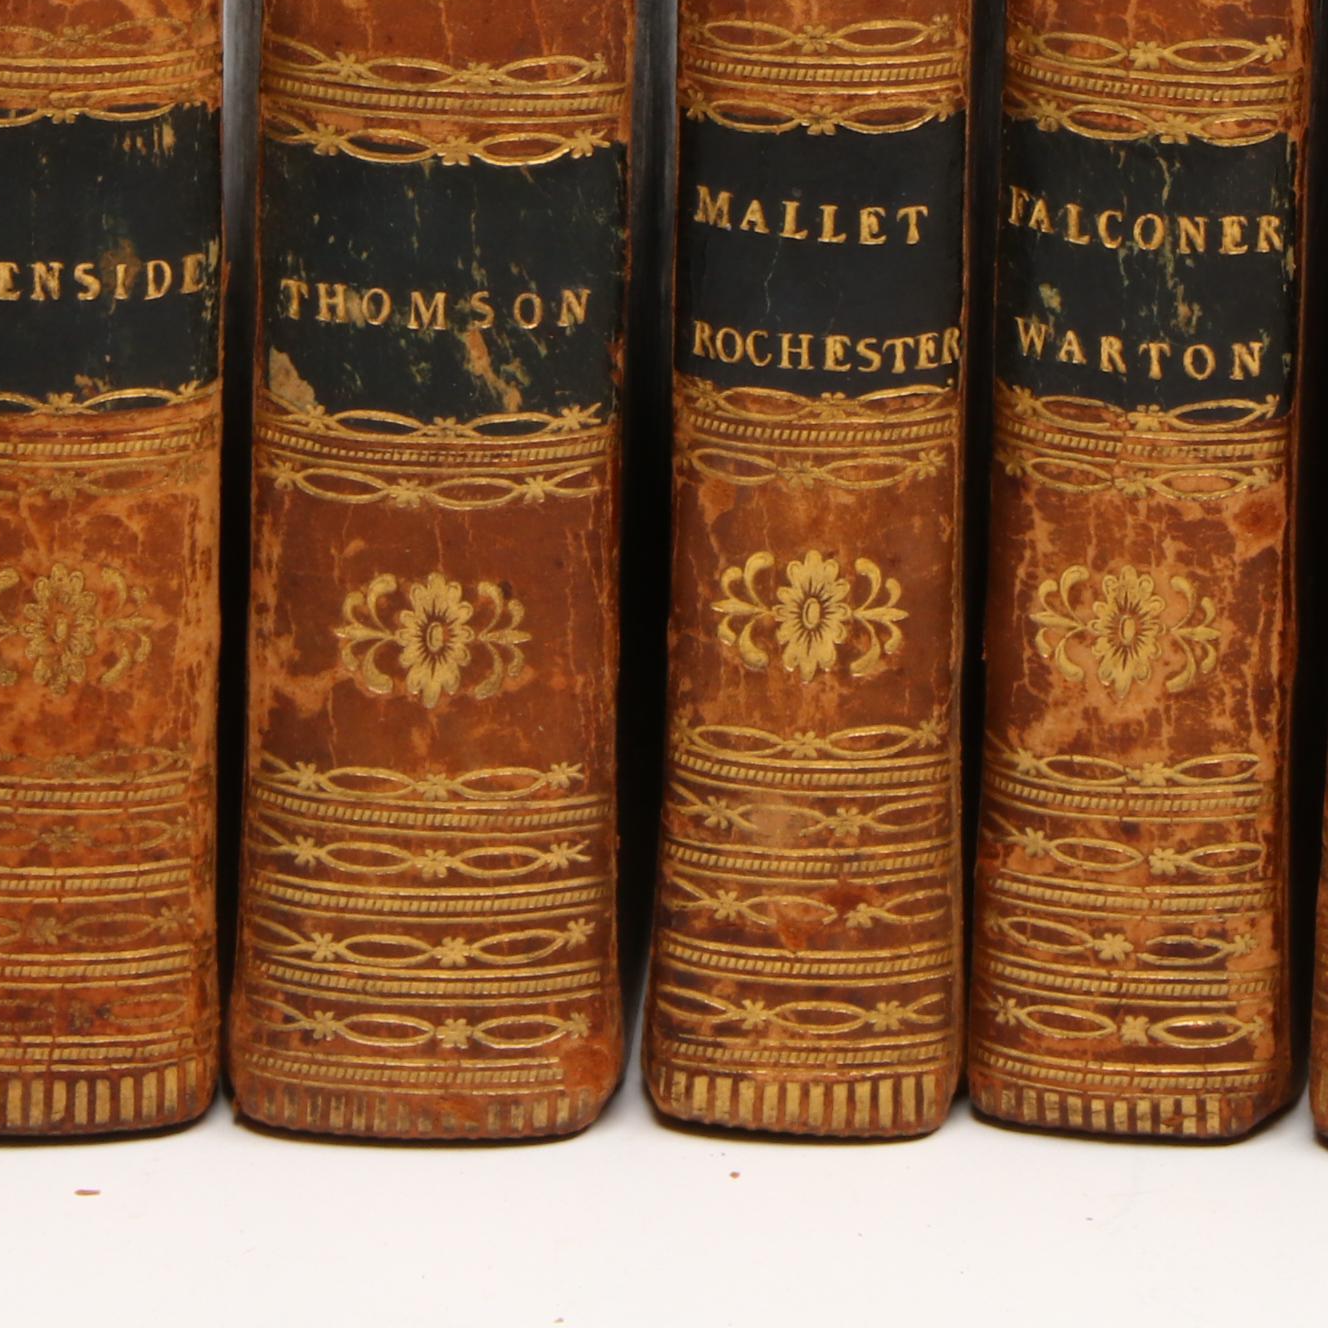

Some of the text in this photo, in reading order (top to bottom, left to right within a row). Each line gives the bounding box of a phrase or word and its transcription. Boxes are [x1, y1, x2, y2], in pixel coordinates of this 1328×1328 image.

[695, 185, 929, 246] MALLET
[1008, 184, 1284, 256] FALCONER
[279, 278, 592, 330] THOMSON
[692, 319, 961, 374] ROCHESTER
[1014, 315, 1265, 380] WARTON
